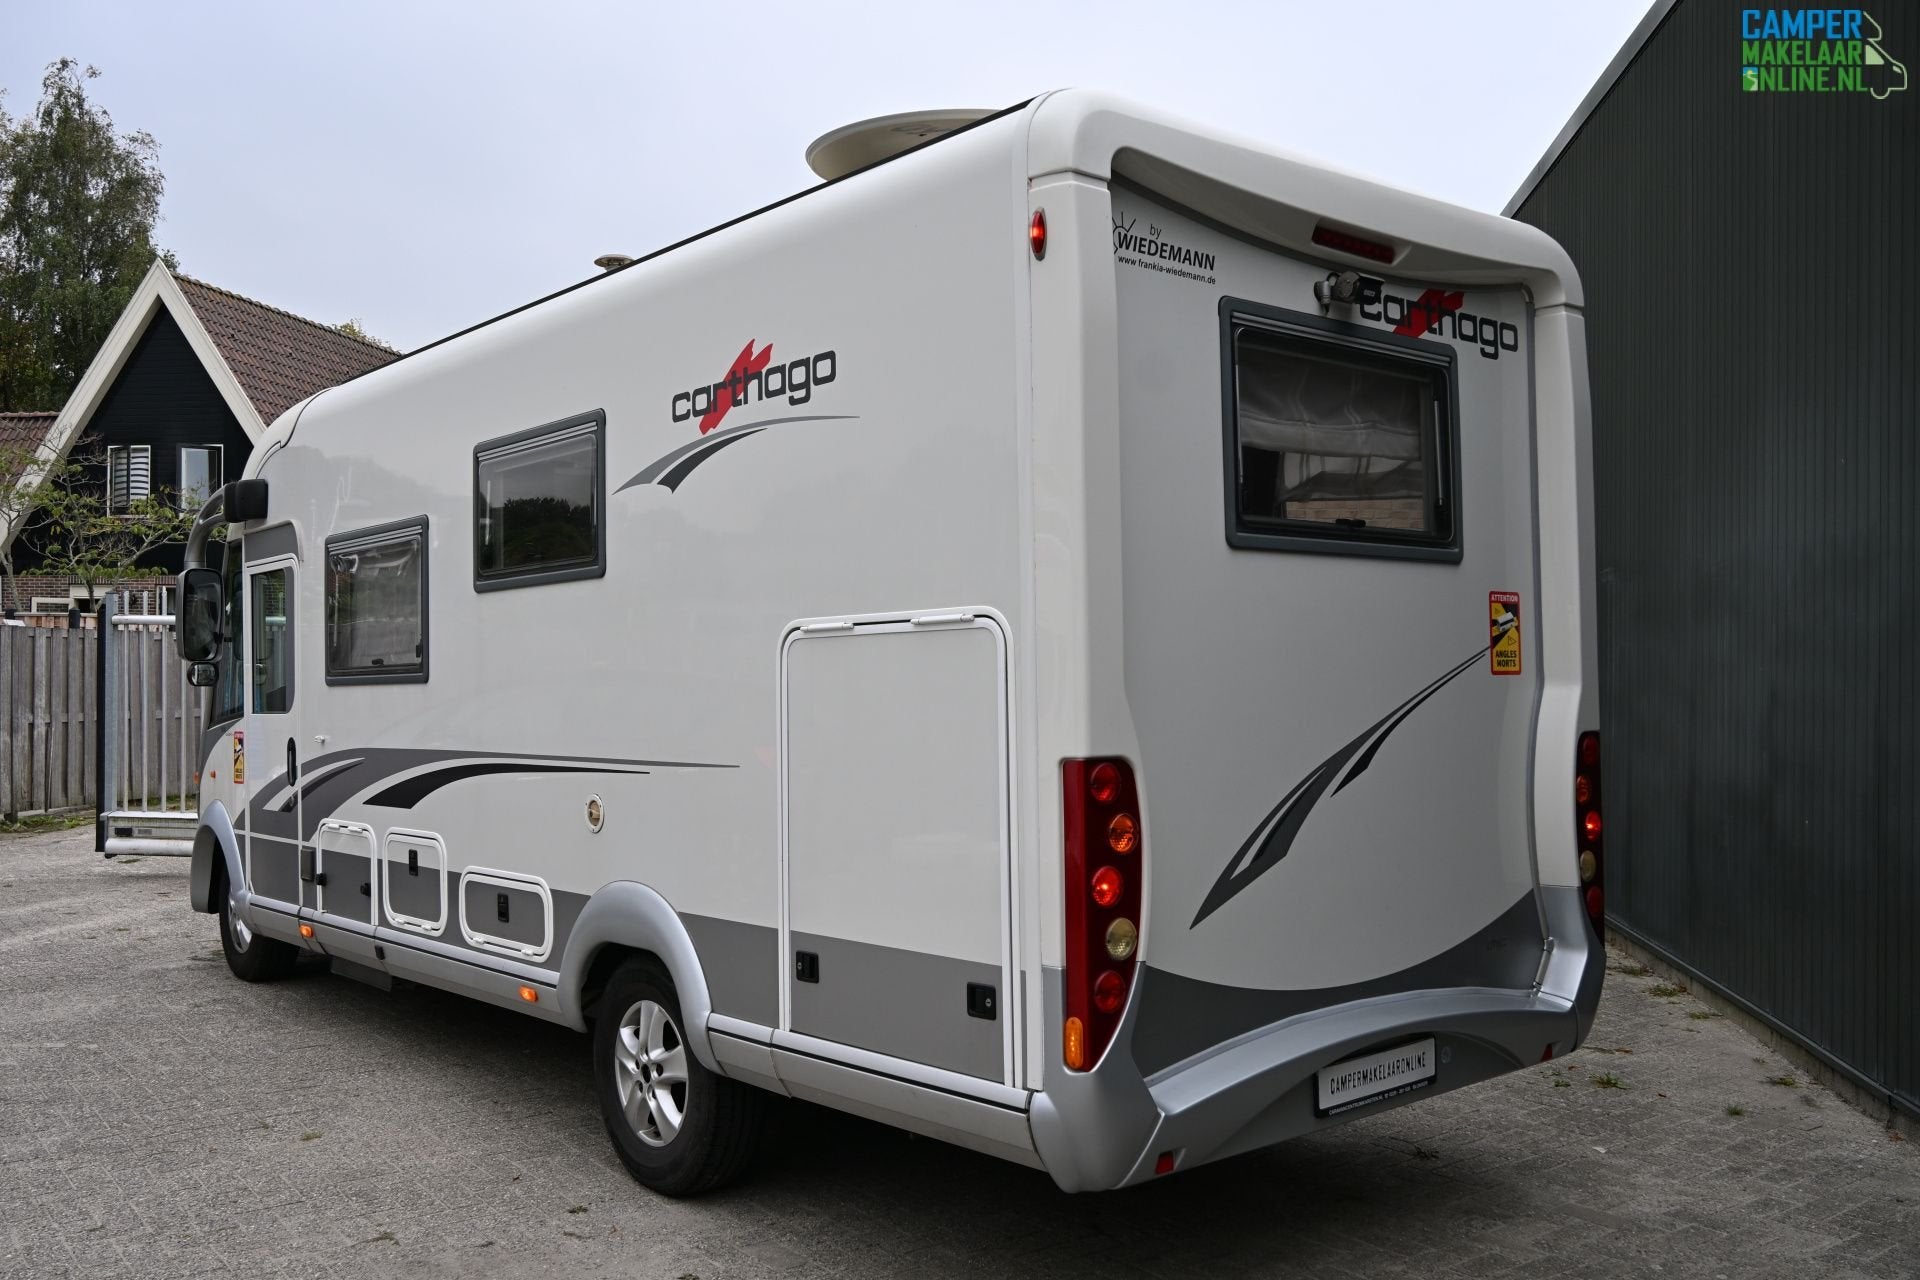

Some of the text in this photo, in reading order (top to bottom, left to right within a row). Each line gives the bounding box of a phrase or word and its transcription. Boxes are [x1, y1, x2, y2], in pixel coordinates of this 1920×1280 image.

[1149, 223, 1162, 240] by
[1117, 231, 1216, 271] WIEDEMANN
[671, 350, 836, 423] carthago
[1495, 650, 1517, 658] ANGLES
[1496, 659, 1516, 668] MORTS
[1330, 1051, 1426, 1095] CAMPERMAKELAARONLINE
